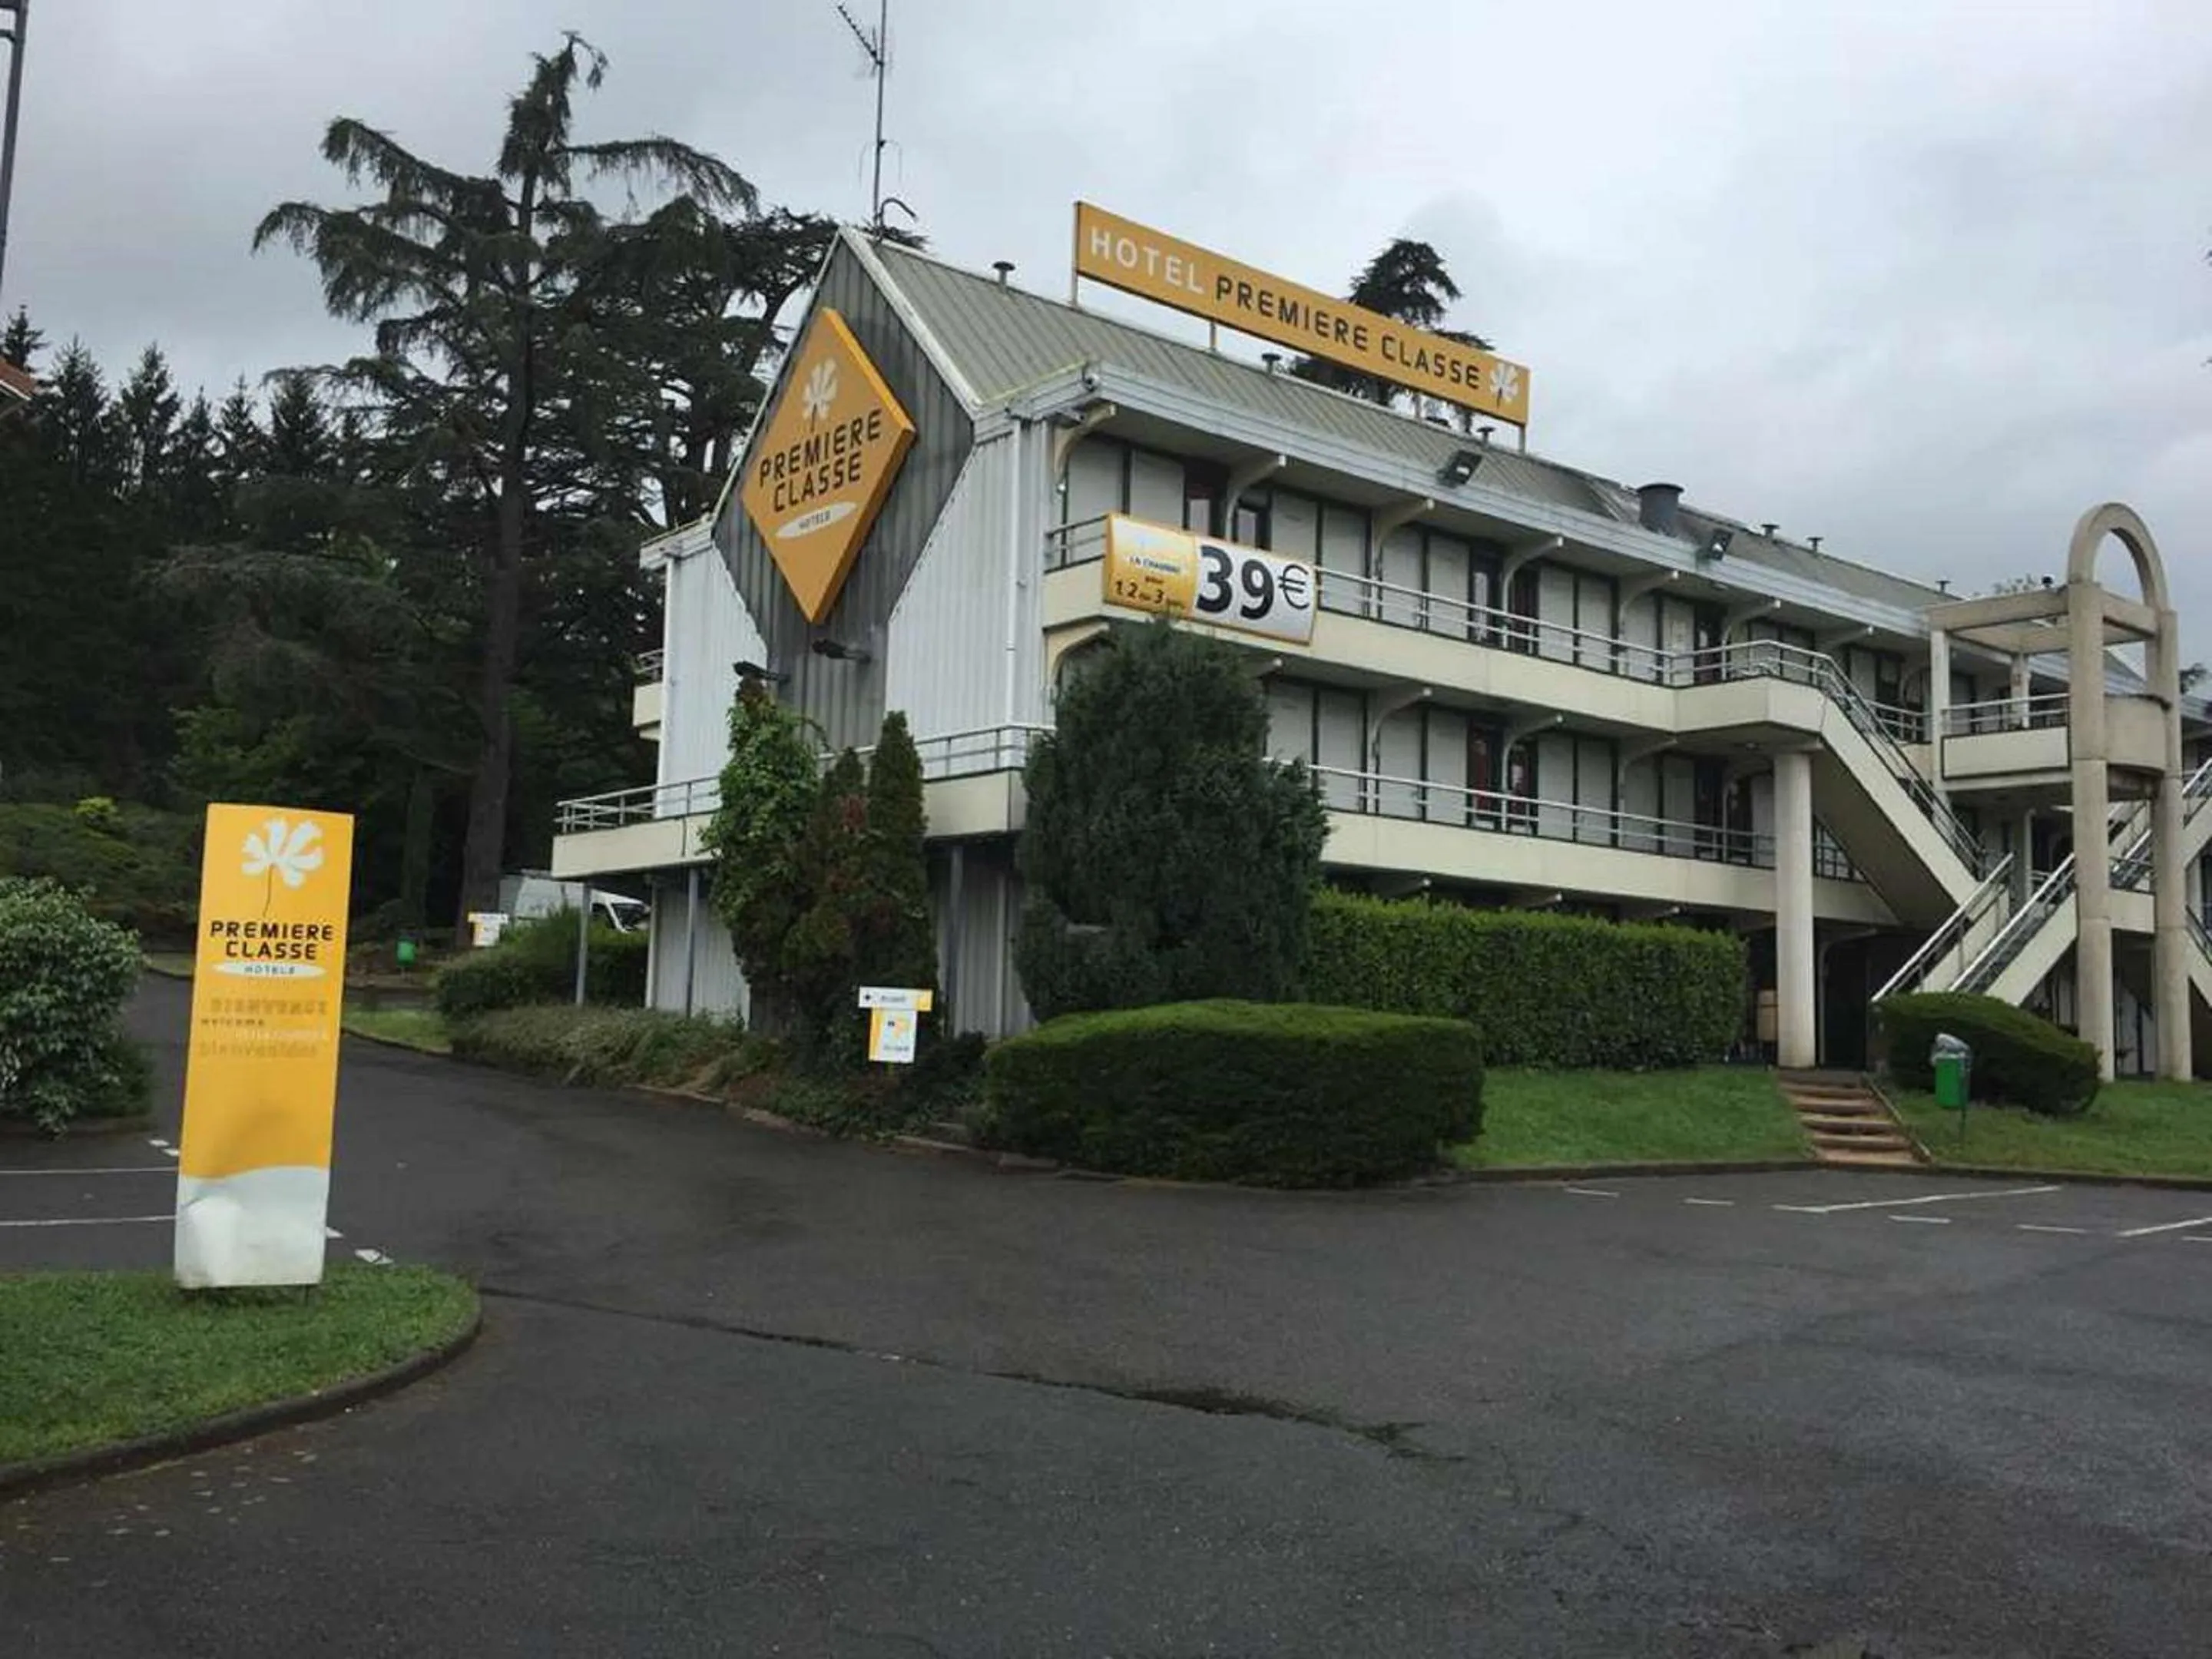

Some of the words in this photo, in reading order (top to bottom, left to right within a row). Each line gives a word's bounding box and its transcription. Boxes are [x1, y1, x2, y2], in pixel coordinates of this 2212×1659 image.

[1090, 227, 1204, 294] HOTEL
[1216, 274, 1369, 352] PREMIERE
[1382, 333, 1480, 390] CLASSE
[759, 408, 883, 488] PREMIERE
[773, 453, 862, 514] CLASSE
[1154, 588, 1164, 604] 3
[210, 920, 334, 941] PREMIERE
[226, 941, 317, 960] CLASSE
